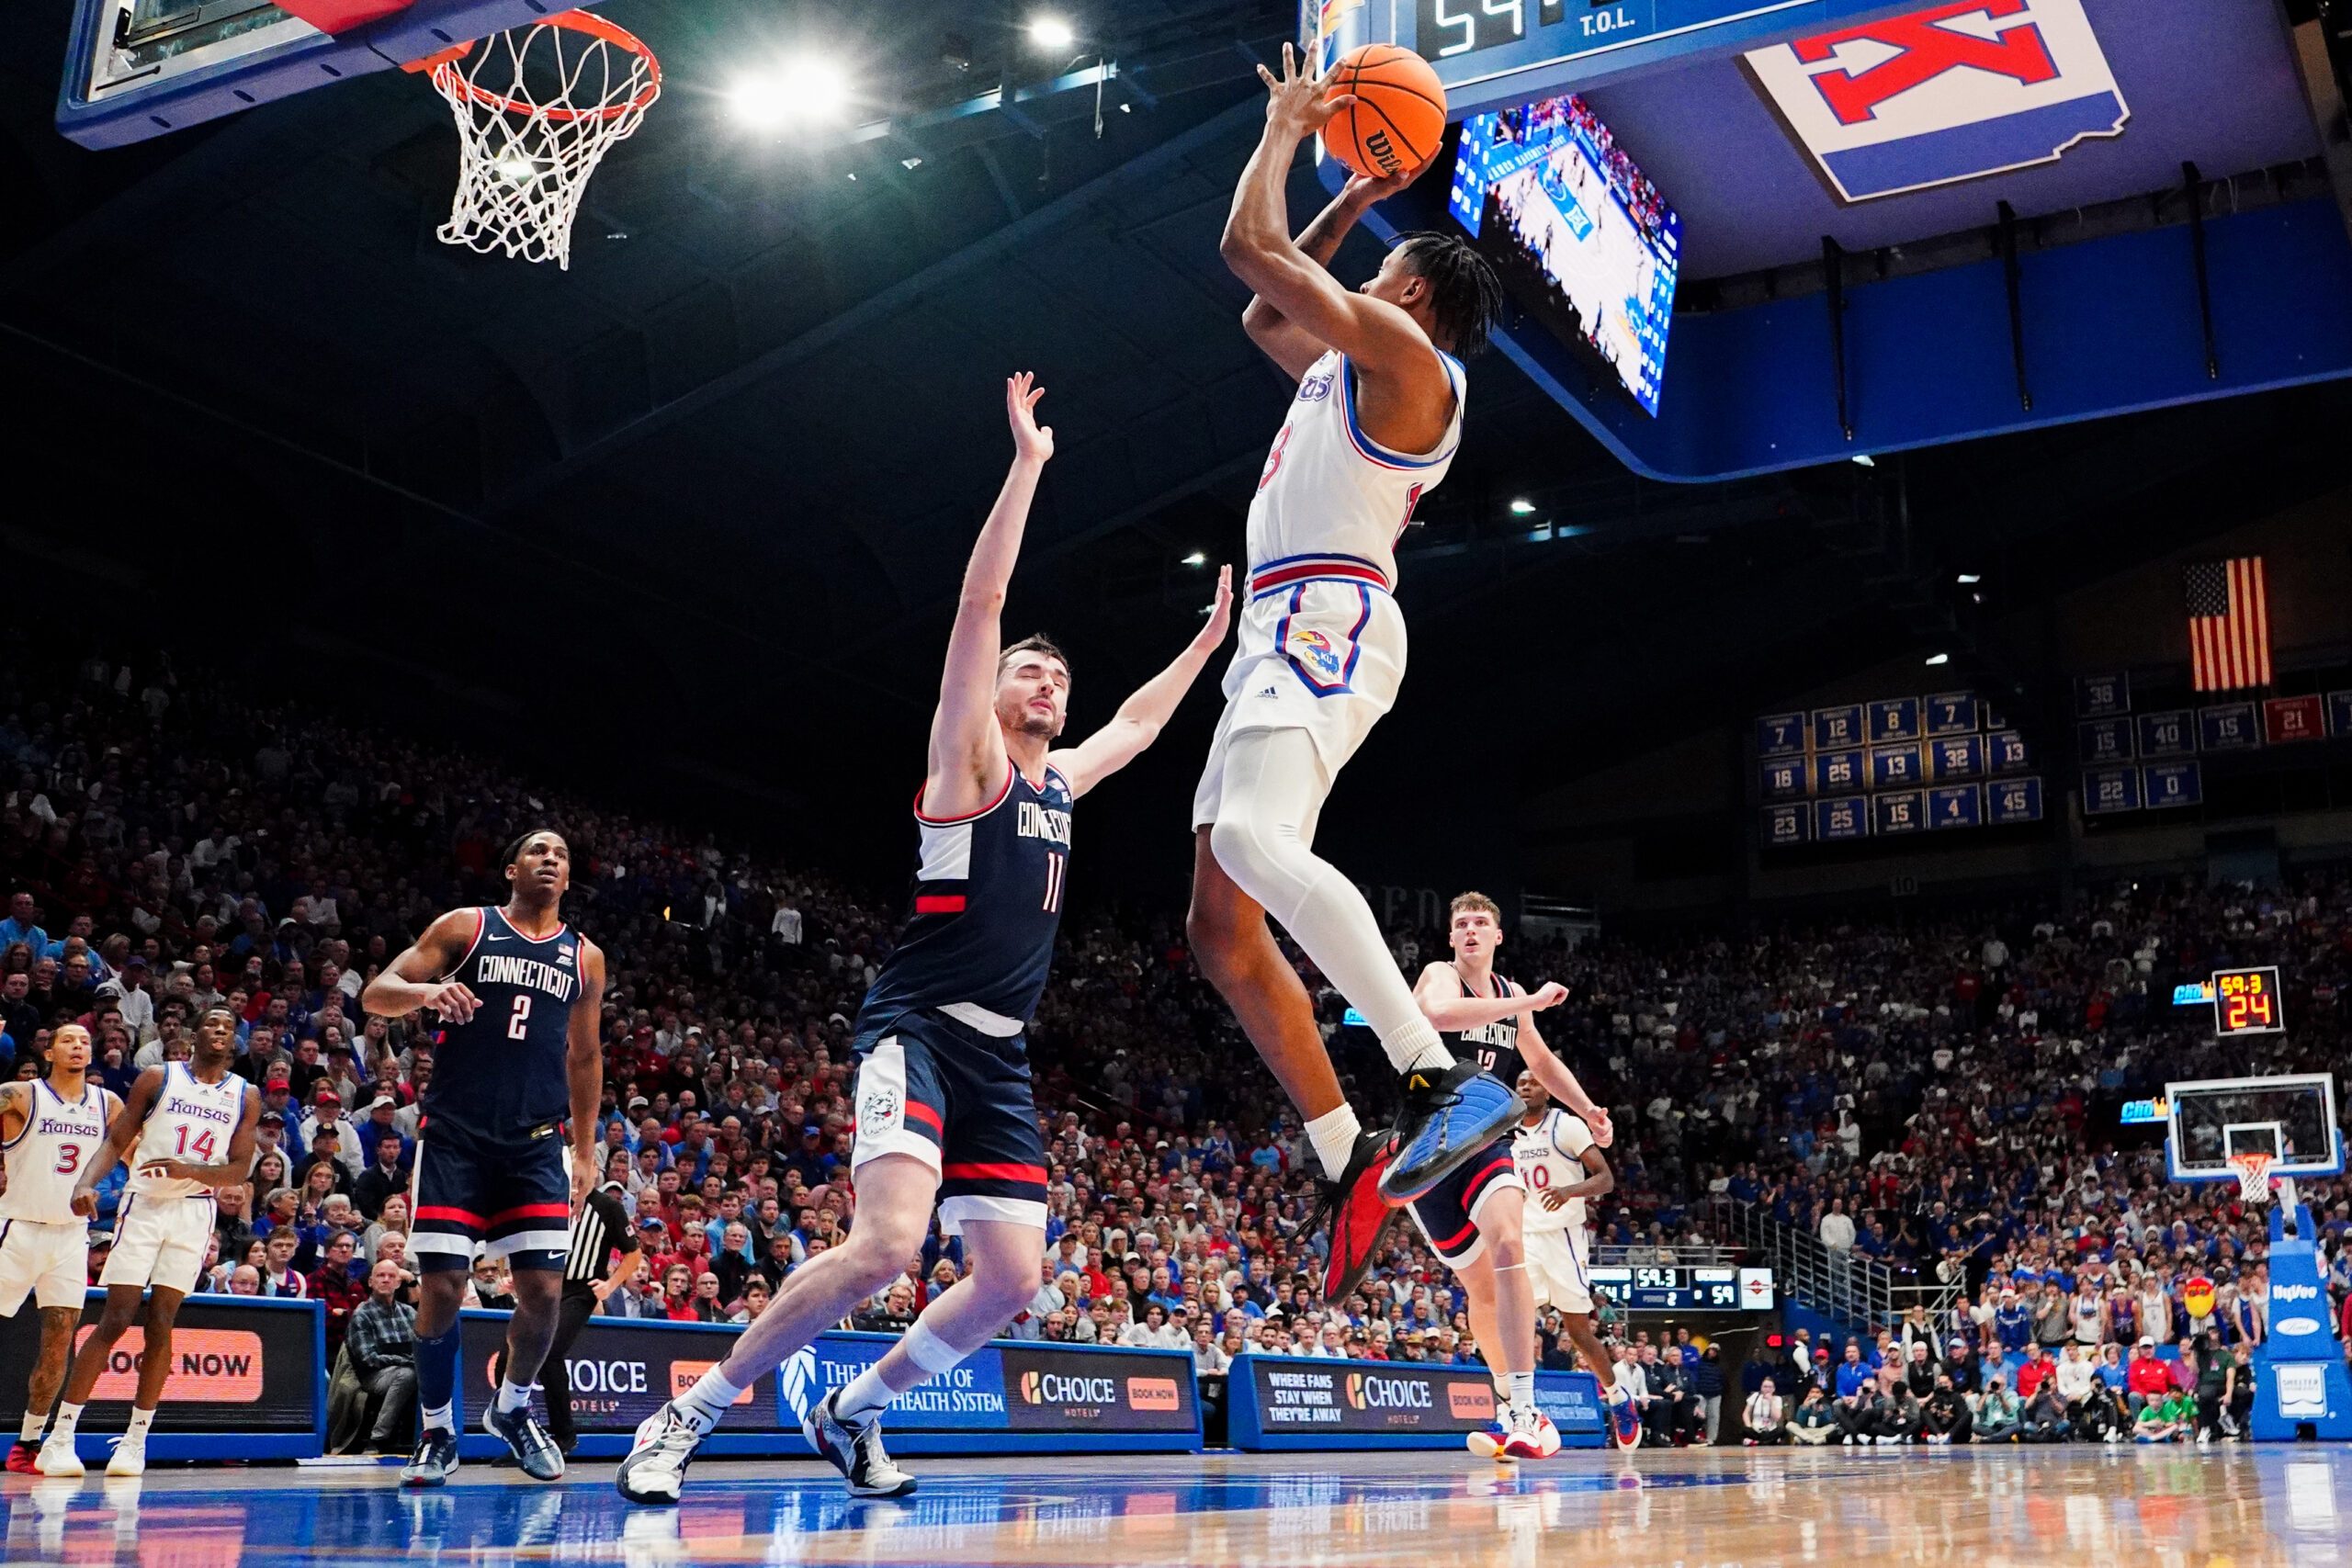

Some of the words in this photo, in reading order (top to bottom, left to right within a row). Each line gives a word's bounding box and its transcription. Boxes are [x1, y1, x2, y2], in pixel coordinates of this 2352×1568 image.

[1579, 7, 1636, 37] T.O.L.
[1365, 130, 1402, 175] Wils
[1828, 719, 1847, 738] 12
[1945, 749, 1969, 769] 32
[2006, 742, 2024, 761] 13
[1887, 756, 1905, 775] 13
[1043, 852, 1063, 913] 11
[478, 954, 574, 1002] CONNECTICUT
[2221, 974, 2262, 997] 59.3
[507, 995, 532, 1041] 2
[2229, 995, 2271, 1028] 24
[167, 1097, 232, 1124] Kansas
[38, 1118, 99, 1137] Kansas
[175, 1123, 218, 1164] 14
[1519, 1148, 1550, 1160] nsas
[55, 1143, 81, 1175] 3
[1638, 1269, 1676, 1287] 59.3
[1712, 1285, 1735, 1304] 59
[182, 1353, 252, 1377] NOW
[821, 1360, 856, 1385] THE
[955, 1369, 974, 1388] OF
[1042, 1373, 1115, 1403] CHOICE
[1268, 1372, 1306, 1388] WHERE
[1306, 1373, 1333, 1389] FANS
[1364, 1376, 1432, 1407] CHOICE
[892, 1391, 950, 1412] HEALTH
[952, 1390, 1005, 1412] SYSTEM
[1132, 1388, 1153, 1399] BOOK
[1274, 1390, 1301, 1404] STAY
[1302, 1391, 1332, 1405] WHEN
[570, 1400, 616, 1412] OTELS
[1064, 1408, 1098, 1417] HOTELS
[1269, 1407, 1311, 1422] THEY'RE
[1312, 1407, 1341, 1422] AWAY
